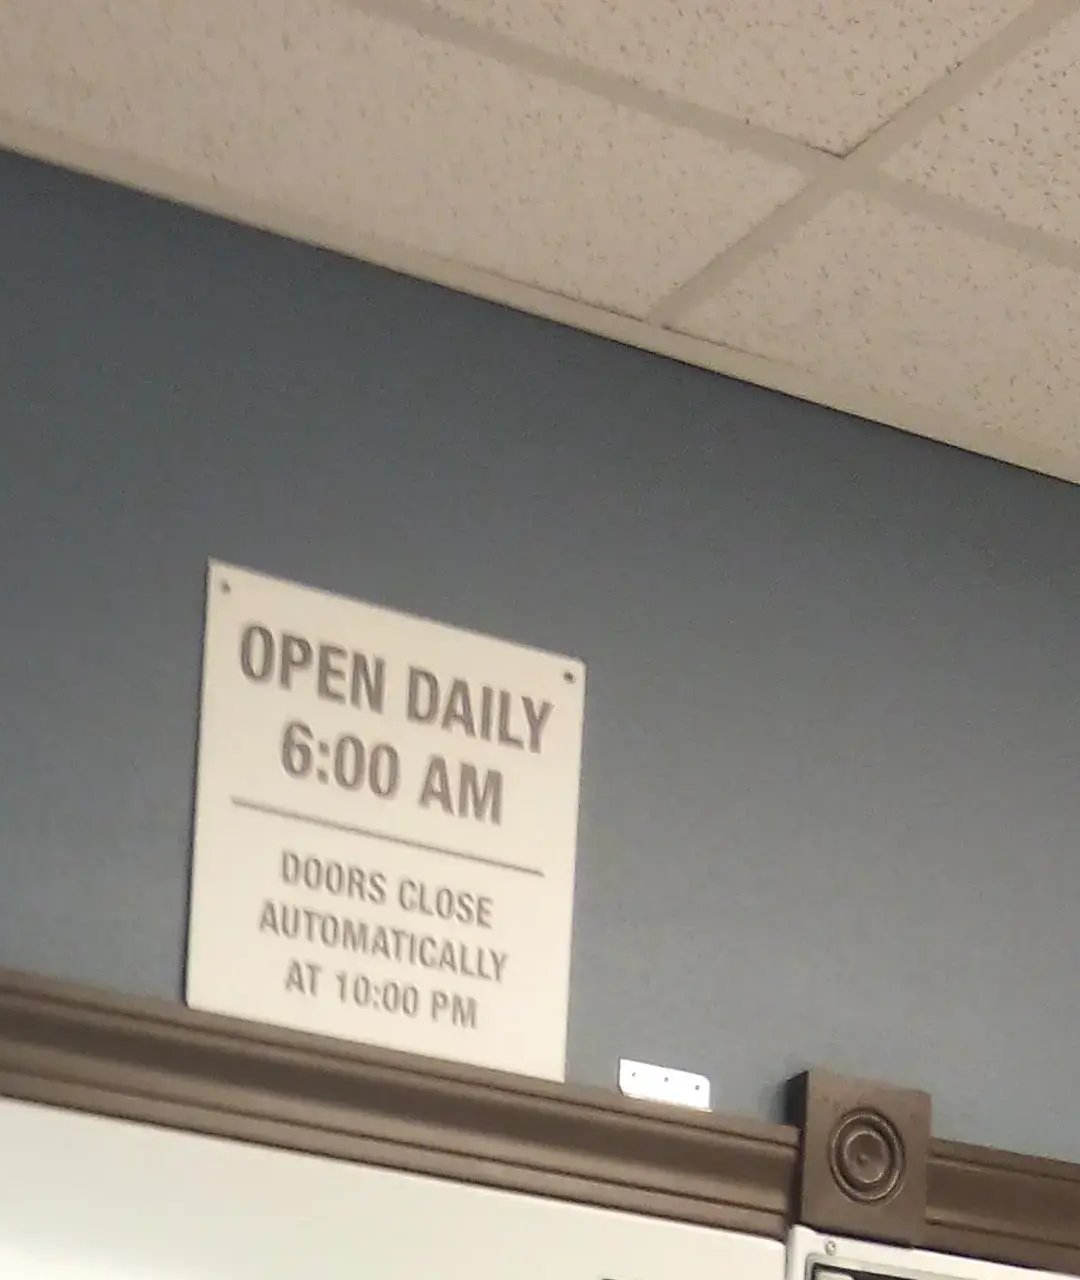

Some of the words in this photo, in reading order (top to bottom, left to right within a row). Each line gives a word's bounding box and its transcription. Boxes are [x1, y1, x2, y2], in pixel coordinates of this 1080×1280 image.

[240, 625, 385, 714] OPEN
[407, 665, 554, 754] DAILY
[280, 719, 400, 799] 6:00
[418, 753, 504, 826] AM
[281, 849, 387, 904] DOORS
[398, 877, 494, 930] CLOSE
[259, 899, 509, 983] AUTOMATICALLY
[284, 958, 323, 996] AT
[336, 971, 419, 1018] 10:00
[430, 990, 478, 1029] PM
